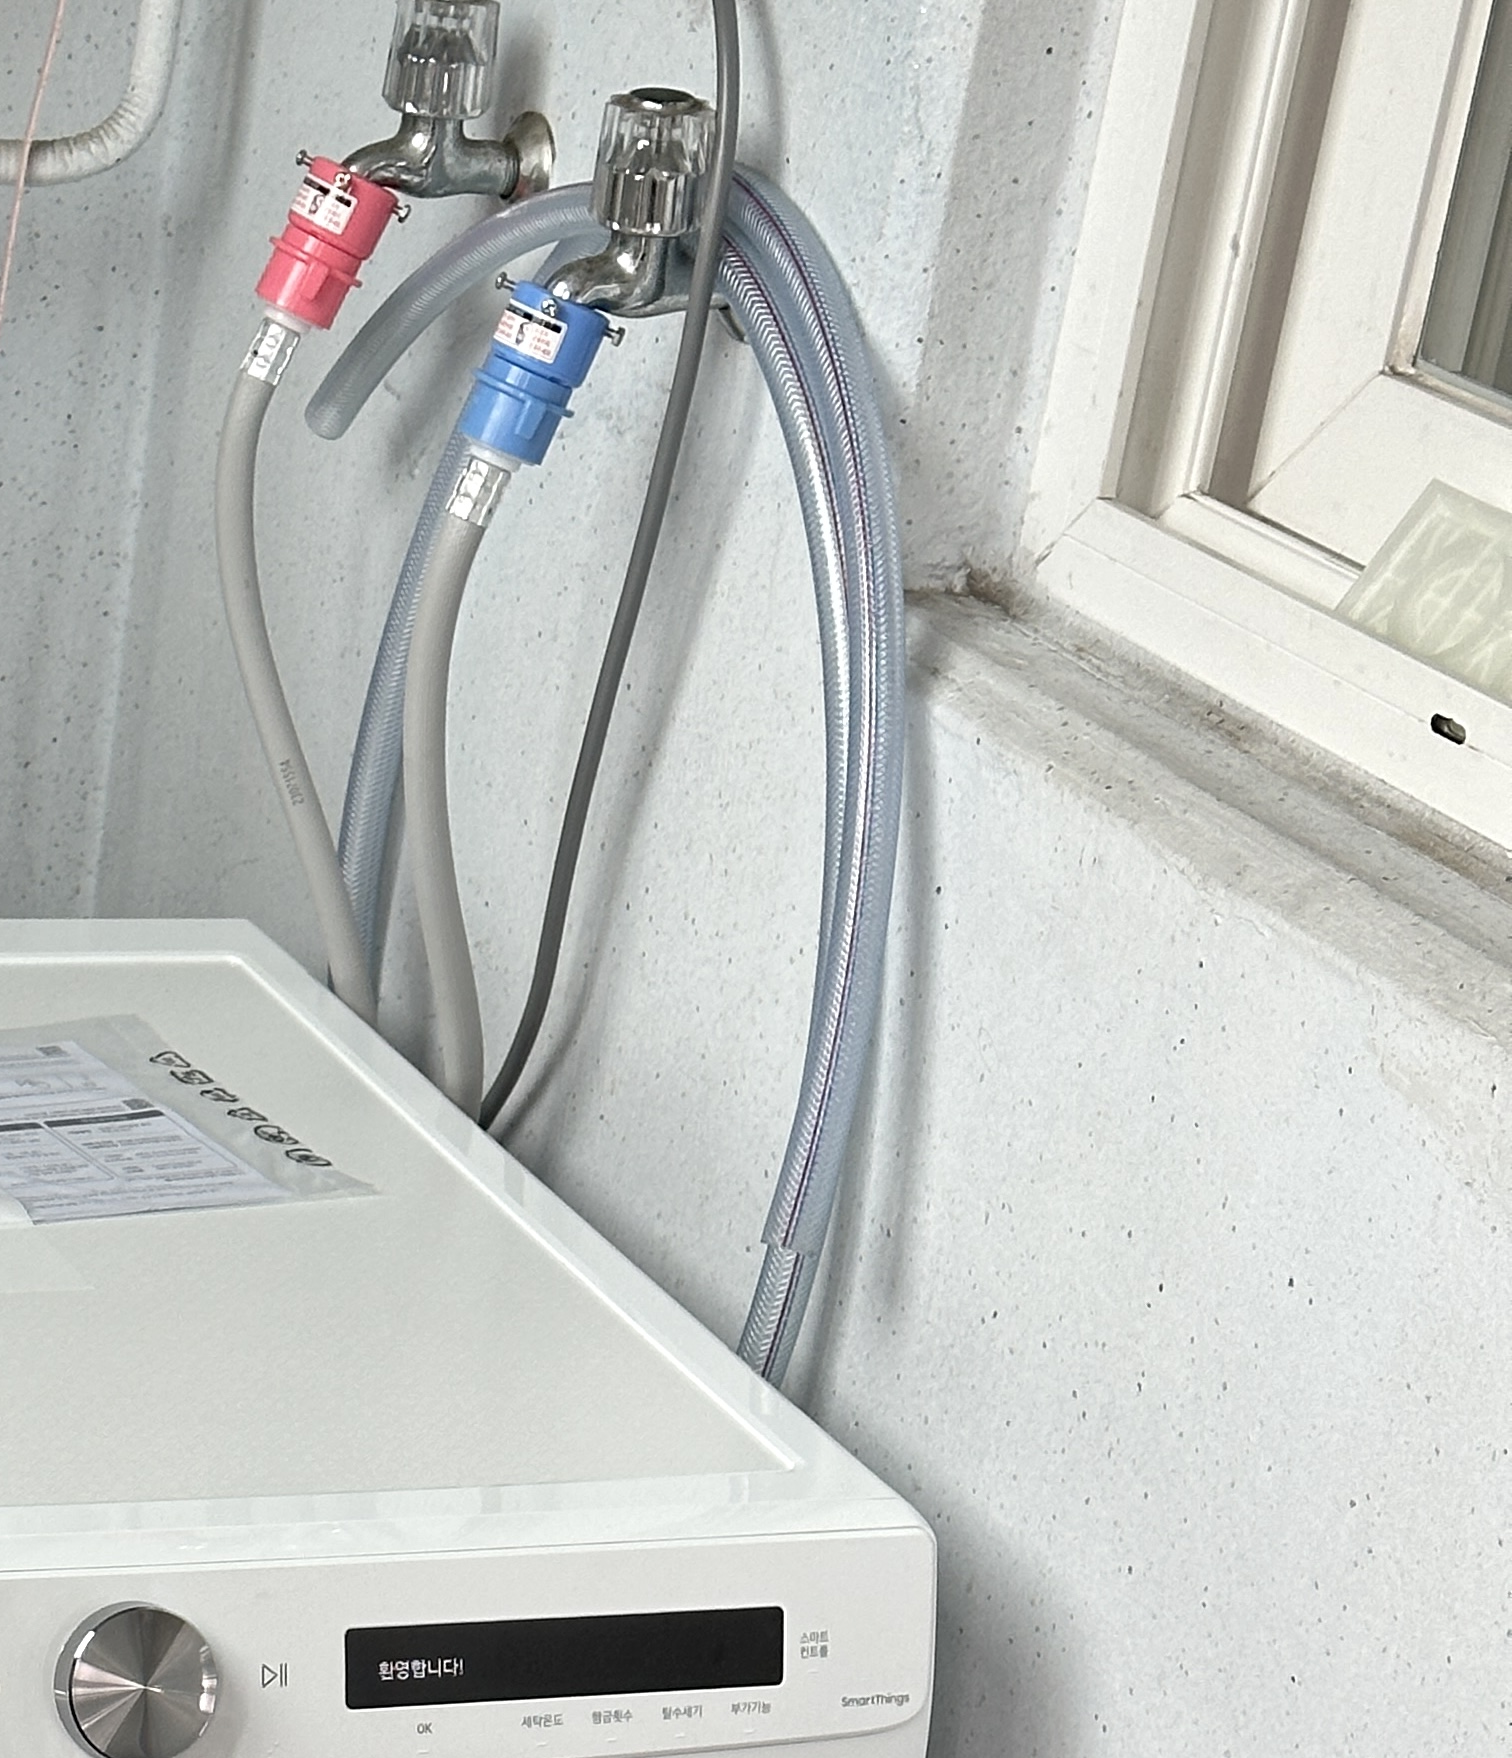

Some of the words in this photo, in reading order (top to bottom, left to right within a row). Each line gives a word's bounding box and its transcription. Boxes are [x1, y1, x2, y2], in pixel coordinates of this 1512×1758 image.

[378, 1657, 464, 1681] 환영합니다!
[841, 1692, 910, 1707] SmartThings
[416, 1721, 433, 1734] OK
